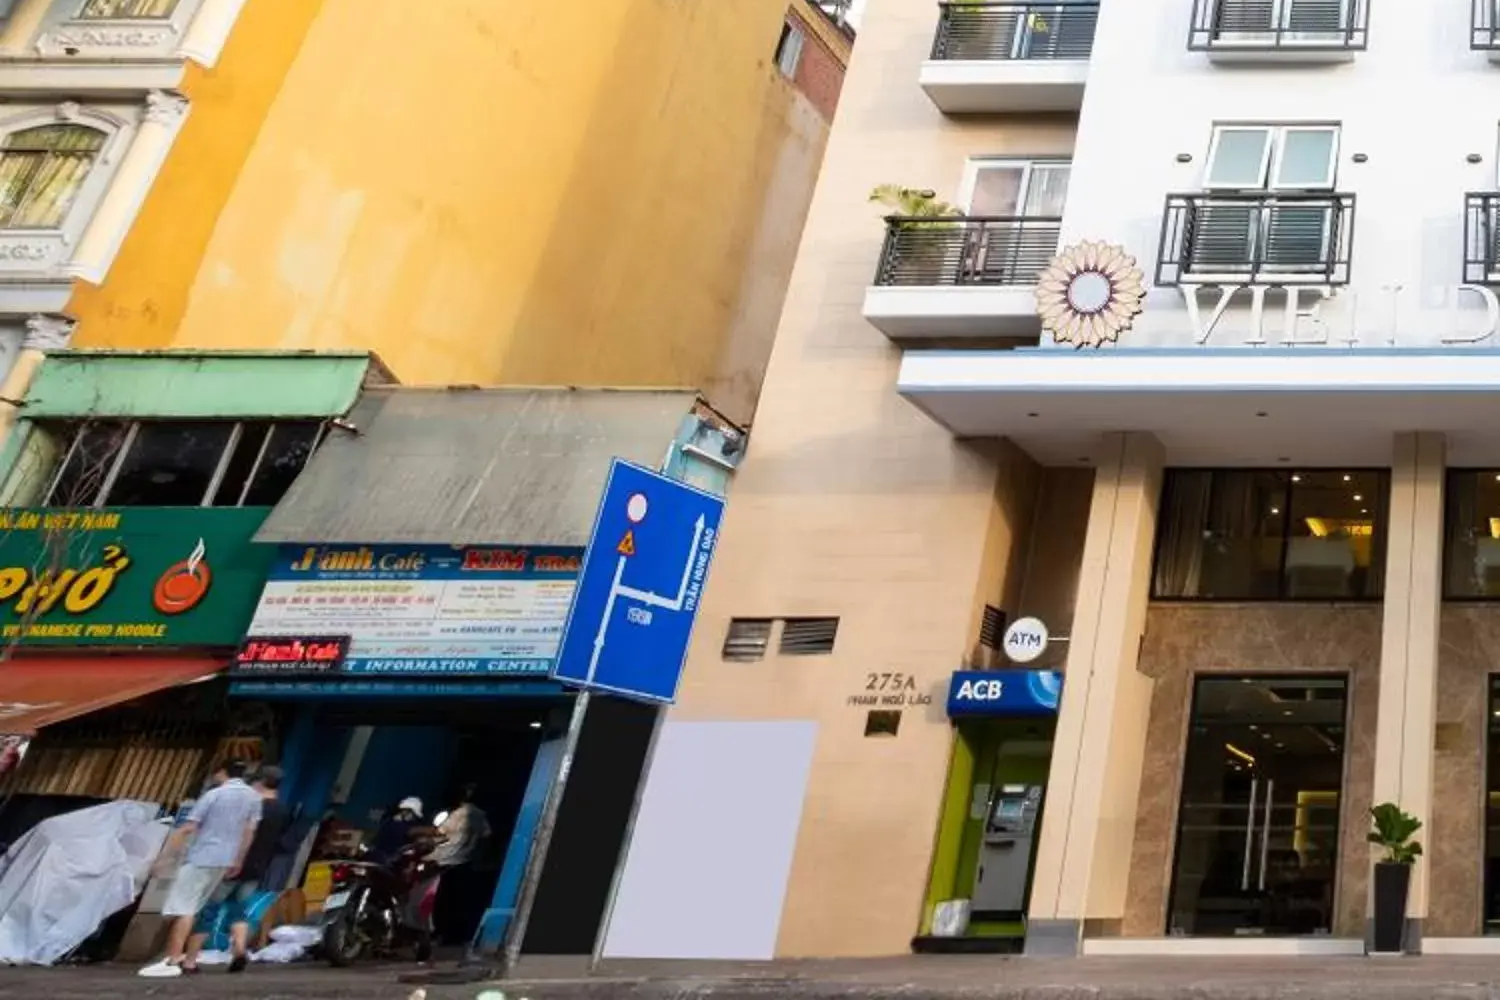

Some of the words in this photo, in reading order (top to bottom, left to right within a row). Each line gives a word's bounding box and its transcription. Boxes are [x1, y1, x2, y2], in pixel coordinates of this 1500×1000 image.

[1008, 631, 1042, 647] ATM
[364, 659, 478, 671] INFORMATION
[487, 659, 550, 671] CENTER
[866, 673, 916, 690] 275A
[956, 680, 1003, 700] ACB
